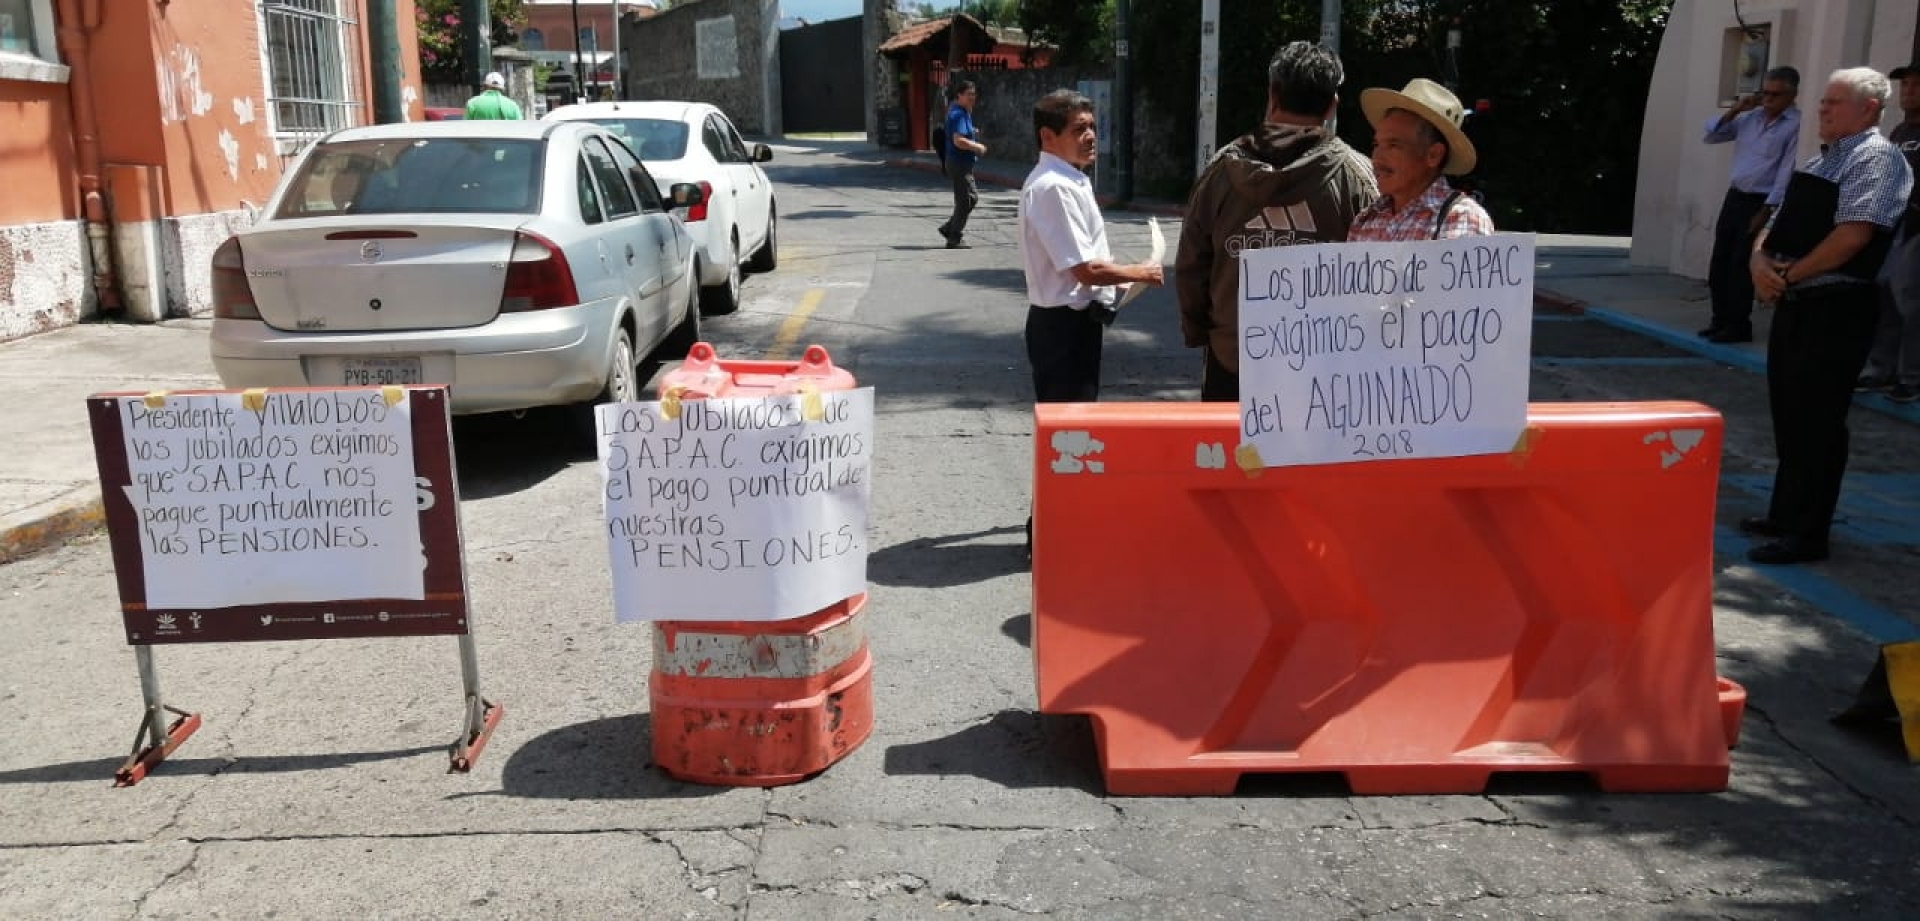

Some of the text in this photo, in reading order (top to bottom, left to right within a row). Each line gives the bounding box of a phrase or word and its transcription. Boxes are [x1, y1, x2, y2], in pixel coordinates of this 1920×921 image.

[1244, 245, 1522, 309] Los jubilados de SAPAC
[1244, 305, 1502, 371] exigimos el pago
[127, 396, 236, 430] Presidente
[602, 394, 849, 441] Los jubilados de
[1244, 363, 1473, 437] del AGUINALDO
[131, 426, 398, 474] los jubilados exigimos
[761, 433, 863, 475] exigimos
[1352, 430, 1414, 456] 2018
[137, 470, 174, 504] que
[323, 466, 376, 488] nos
[606, 462, 865, 511] el pago puntual de
[143, 505, 209, 536] pague
[219, 488, 393, 532] puntualmente
[609, 506, 724, 538] nuestras
[150, 521, 379, 554] las PENSIONES.
[627, 525, 859, 571] PENSIONES.
